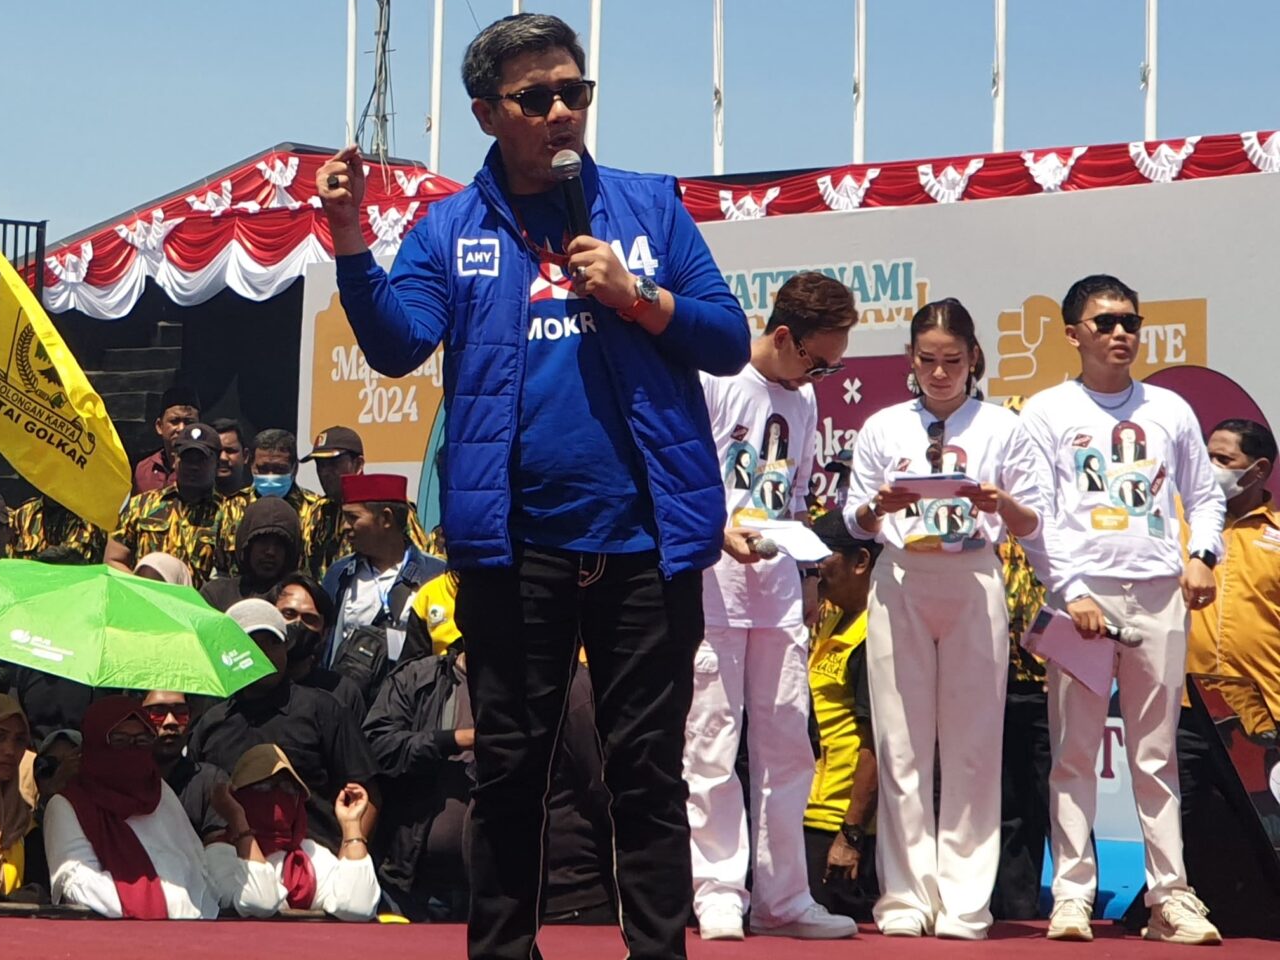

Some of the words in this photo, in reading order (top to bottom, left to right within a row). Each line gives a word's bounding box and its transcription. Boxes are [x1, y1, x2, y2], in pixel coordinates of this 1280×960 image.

[465, 251, 493, 264] AHY
[358, 385, 418, 424] 2024
[45, 408, 77, 439] KARYA
[24, 419, 88, 470] GOLKAR
